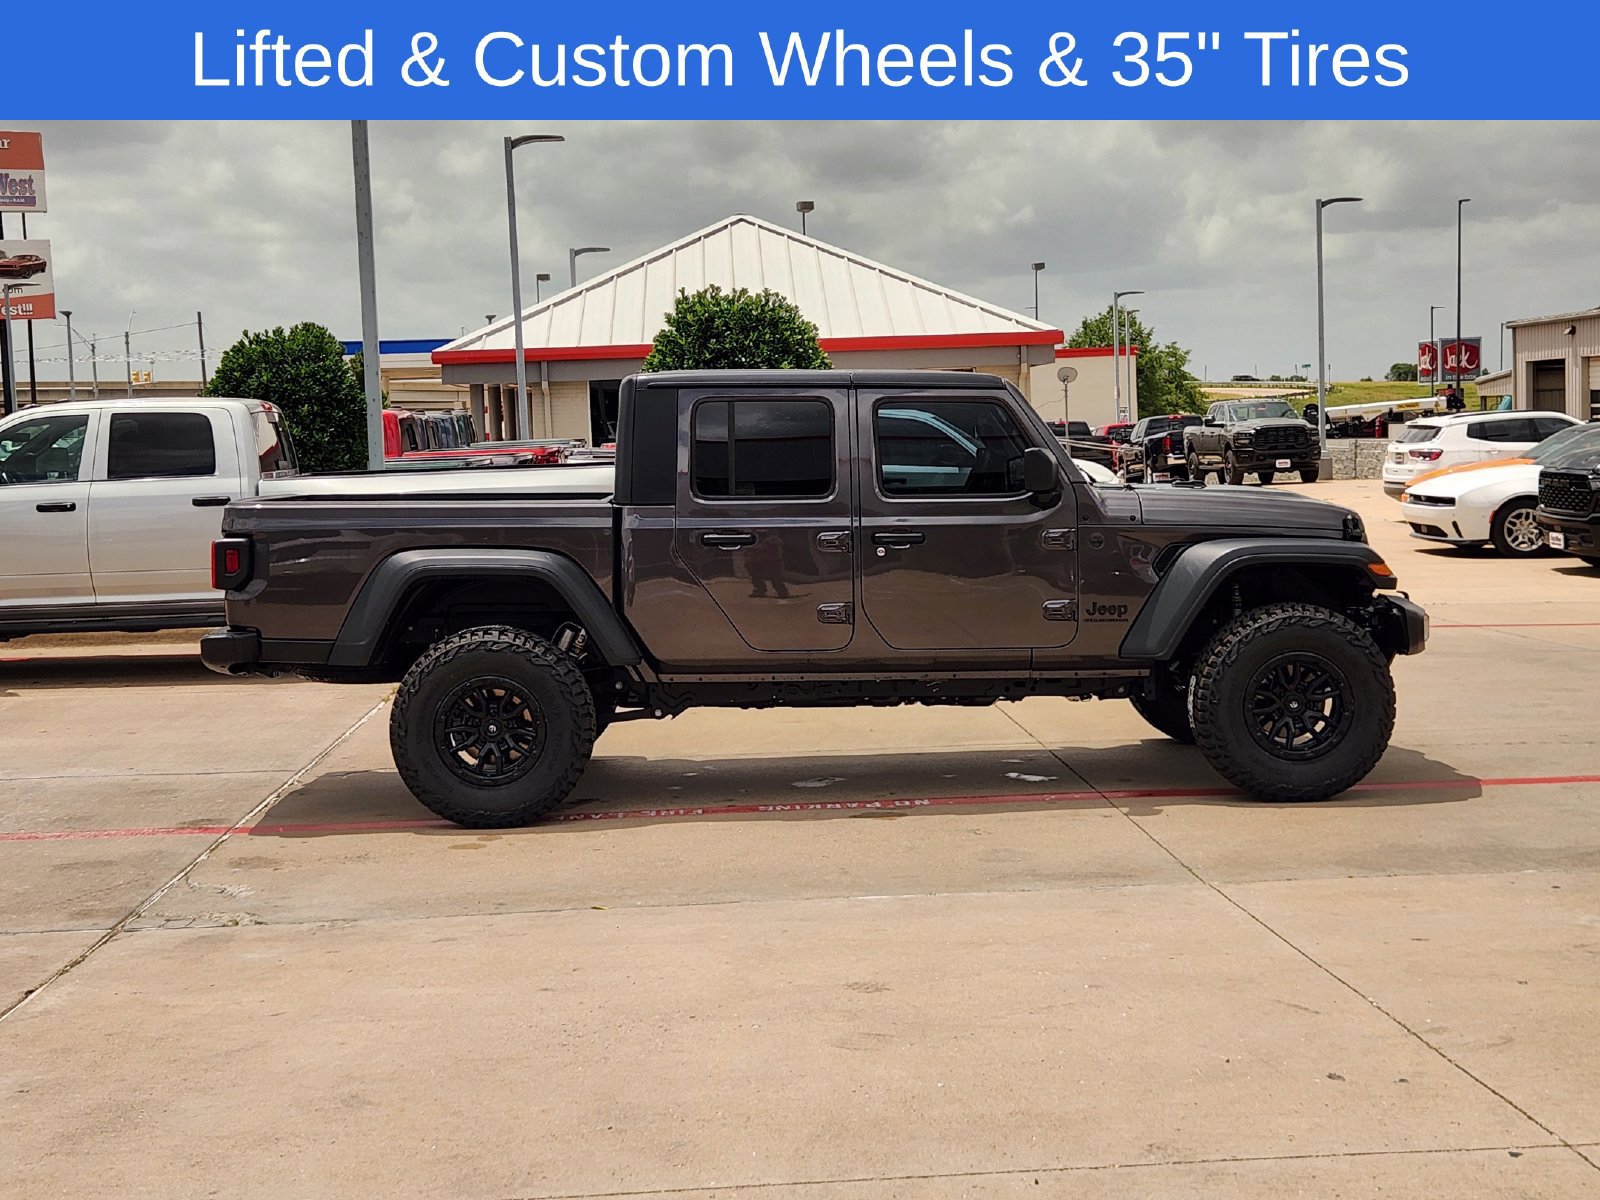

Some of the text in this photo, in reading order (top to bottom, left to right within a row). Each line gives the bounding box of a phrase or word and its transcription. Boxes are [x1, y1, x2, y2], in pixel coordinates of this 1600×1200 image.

[1085, 601, 1129, 618] Jeep
[757, 800, 882, 811] PARKING
[894, 798, 930, 807] NO
[642, 808, 704, 817] FIRE
